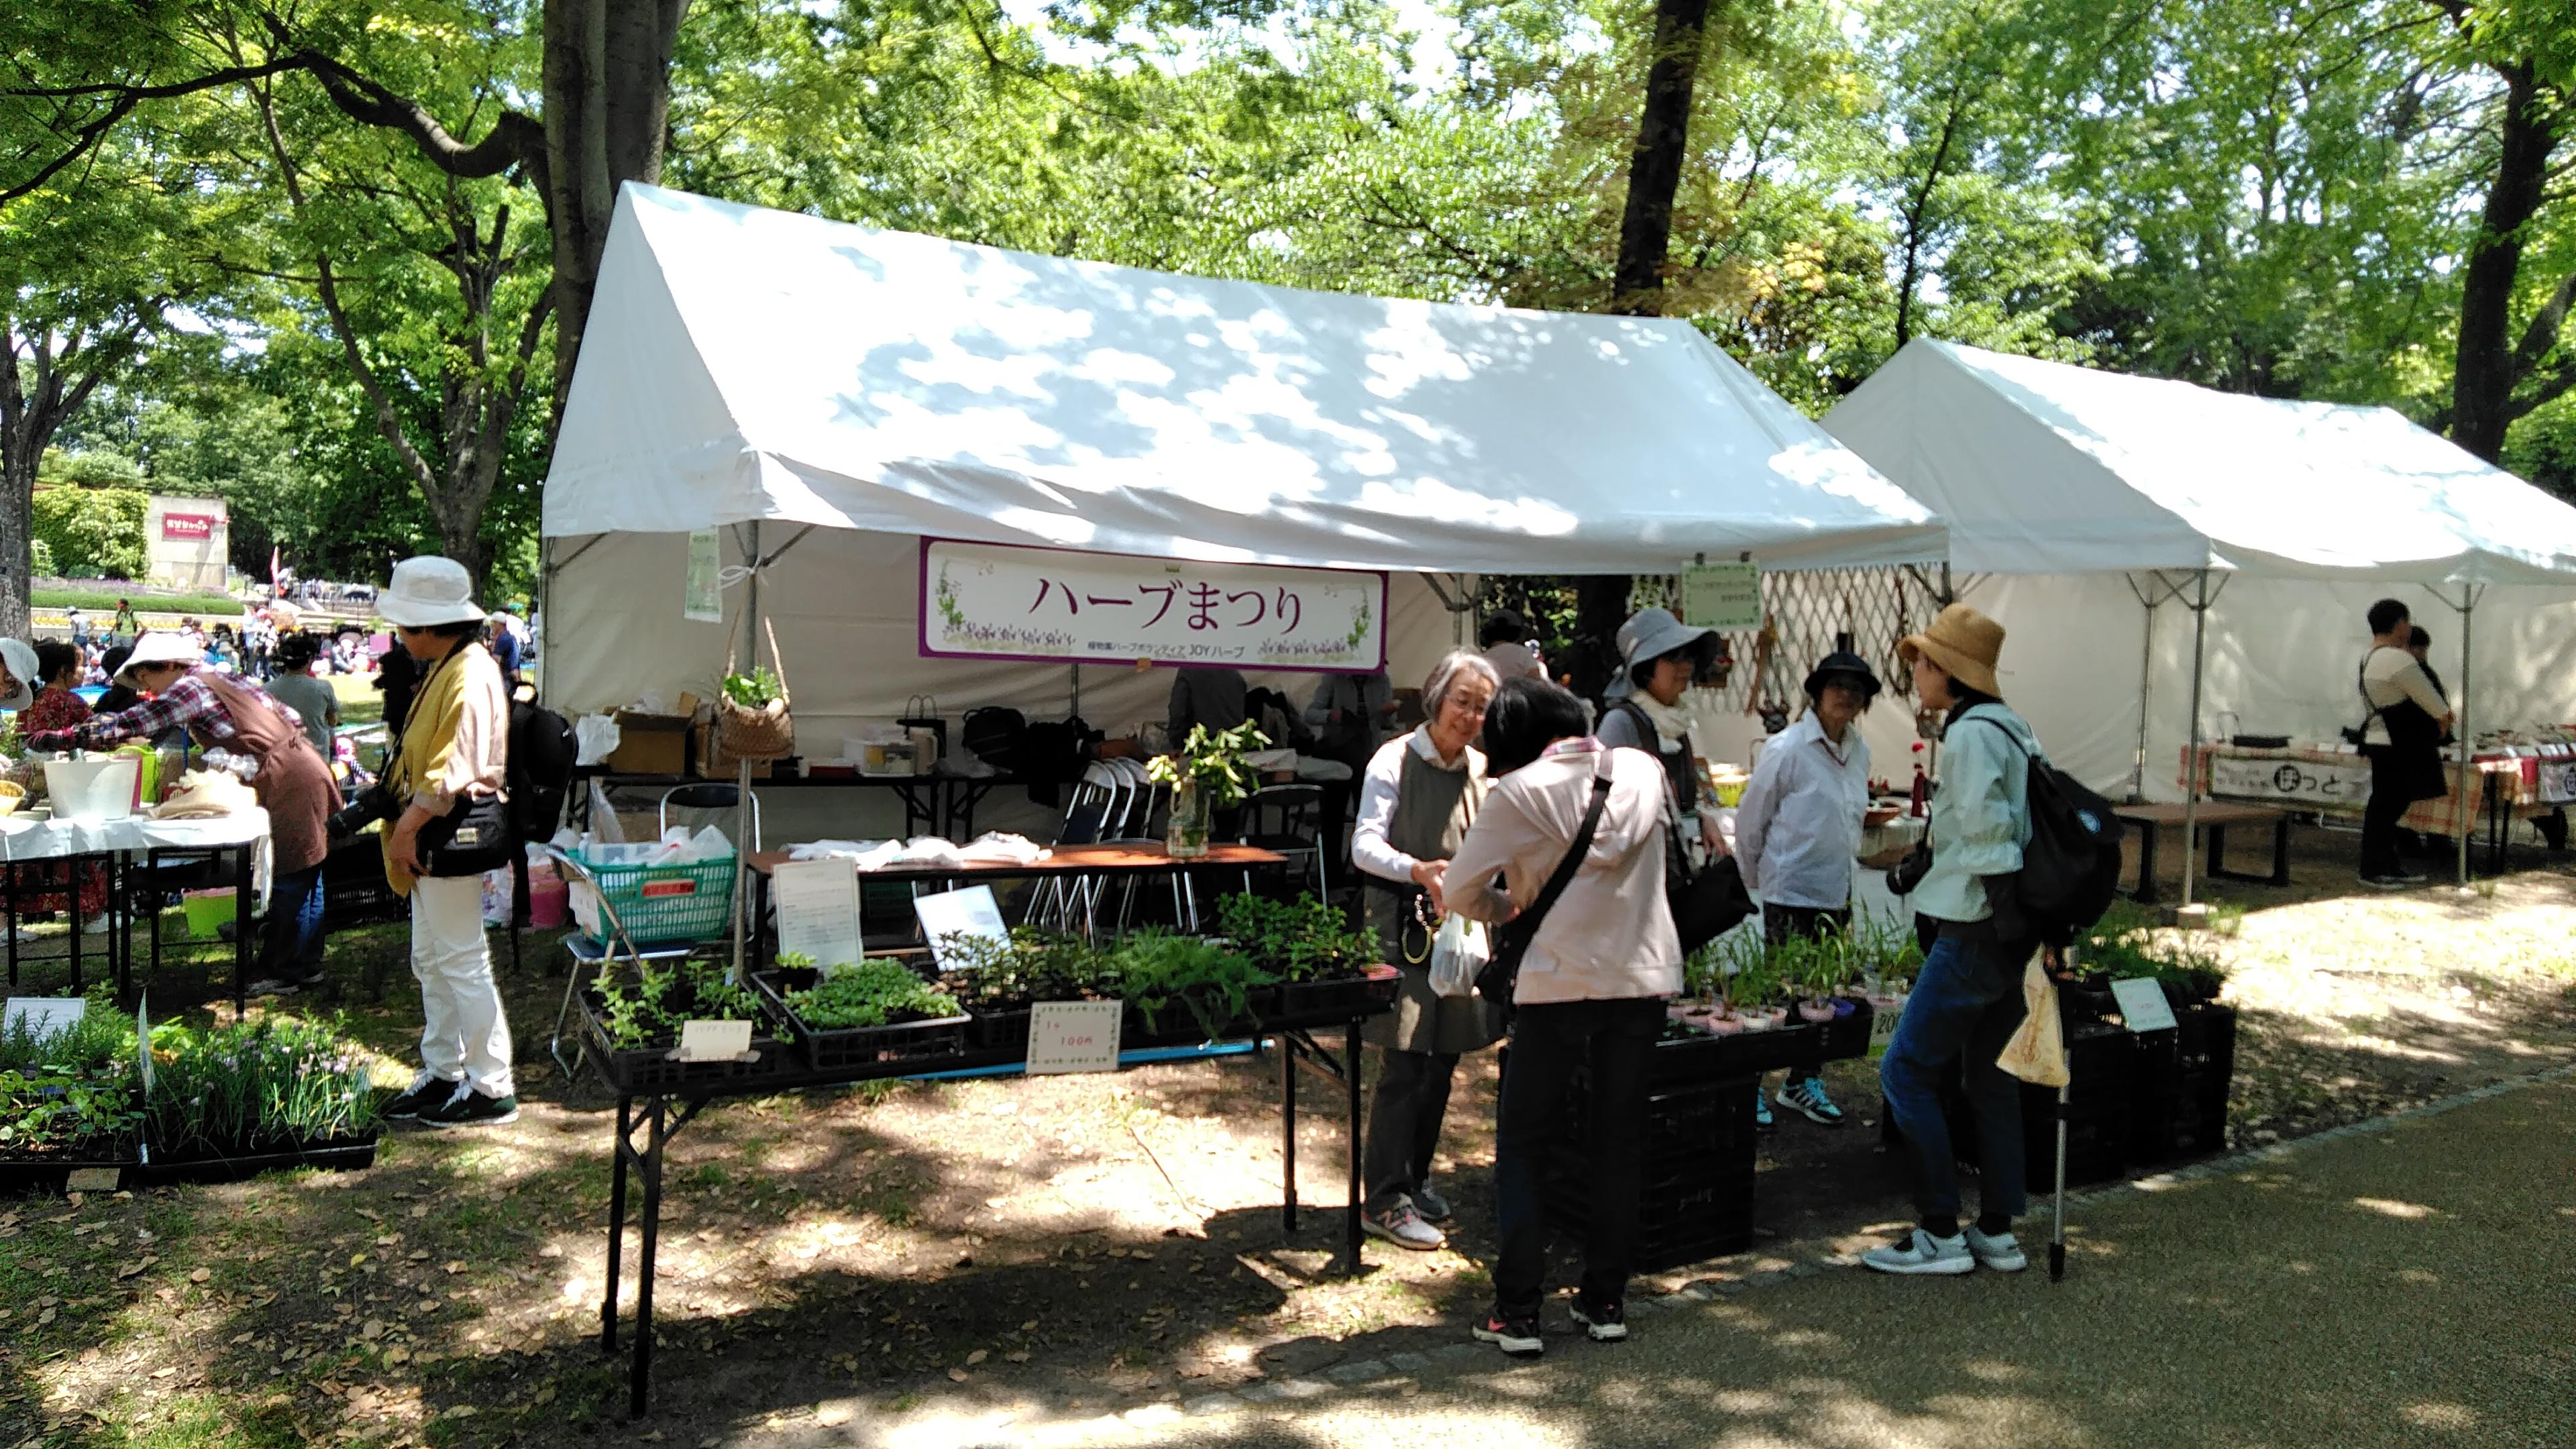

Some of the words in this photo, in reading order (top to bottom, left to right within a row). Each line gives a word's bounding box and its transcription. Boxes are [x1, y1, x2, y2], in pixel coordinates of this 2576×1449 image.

[1028, 578, 1303, 635] ハーブまつり
[1188, 643, 1246, 659] JOYハーブ
